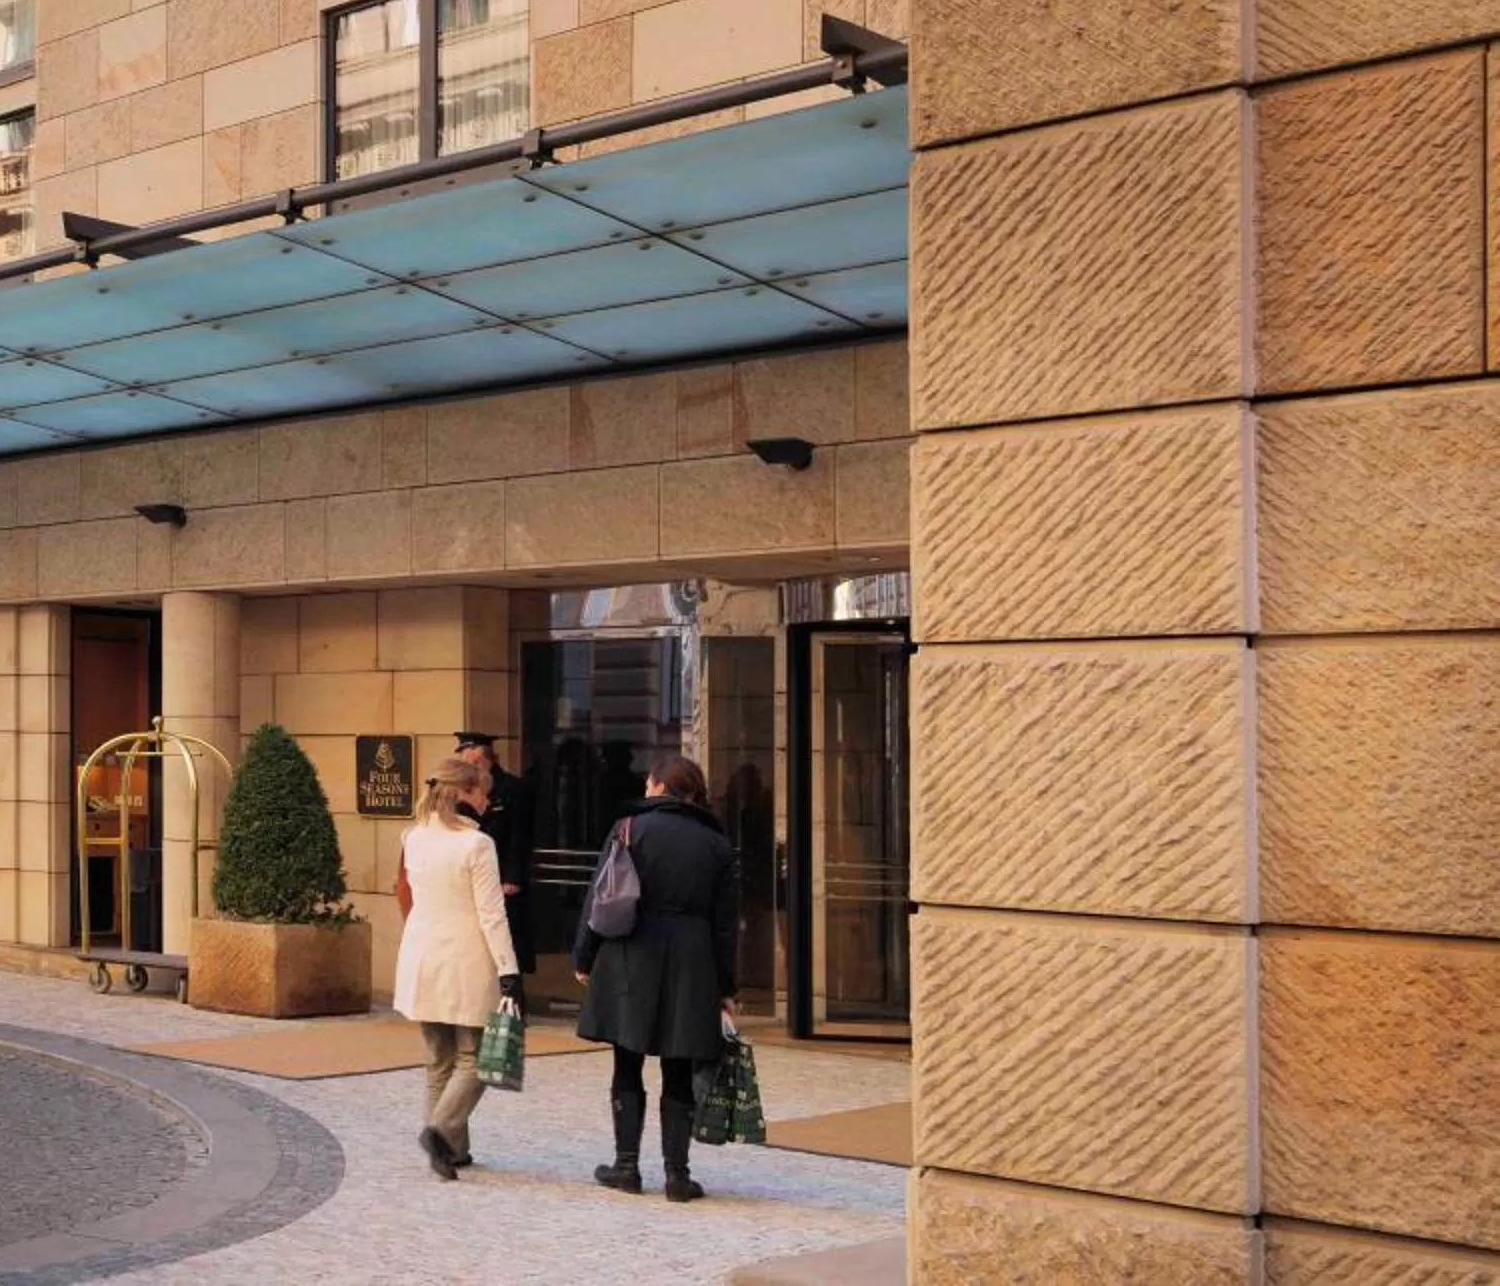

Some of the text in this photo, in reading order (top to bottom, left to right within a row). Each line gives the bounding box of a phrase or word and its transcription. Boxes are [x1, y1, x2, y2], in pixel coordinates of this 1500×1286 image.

[369, 770, 401, 783] FOUR
[360, 782, 409, 794] SEASONS
[365, 795, 404, 807] HOTEL
